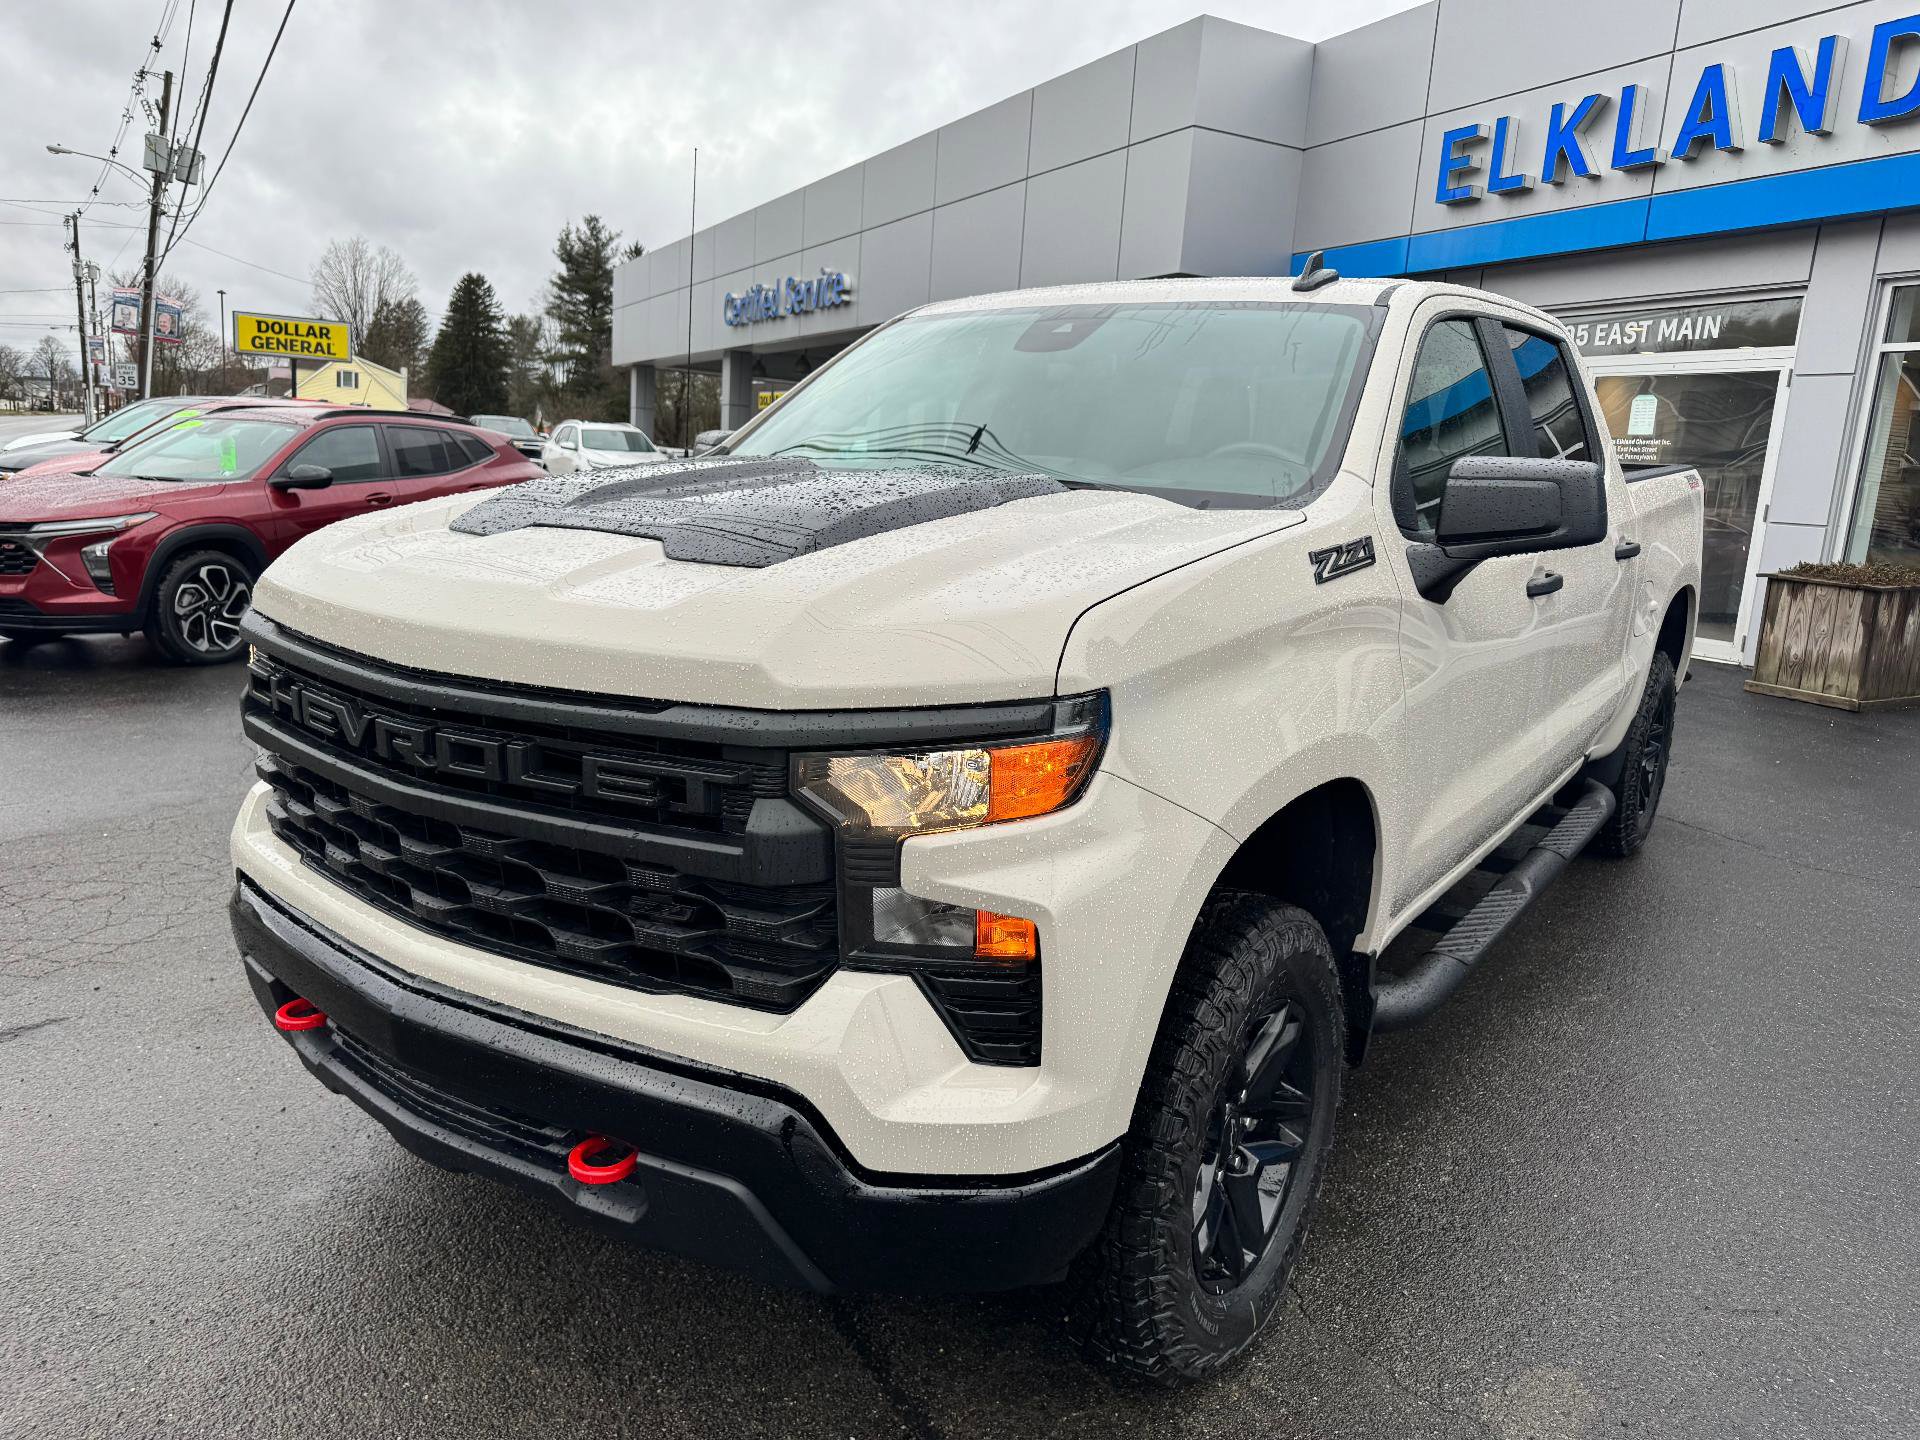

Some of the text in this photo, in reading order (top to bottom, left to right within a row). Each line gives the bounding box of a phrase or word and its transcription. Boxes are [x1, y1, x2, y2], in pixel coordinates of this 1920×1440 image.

[1435, 15, 1920, 204] ELKLAND
[724, 267, 850, 327] Certified Service
[251, 335, 337, 356] GENERAL
[256, 319, 331, 340] DOLLAR
[1594, 320, 1654, 346] EAST
[1657, 315, 1722, 342] MAIN
[118, 375, 136, 386] 35
[1308, 535, 1376, 585] Z71
[247, 661, 751, 816] CHEVROLET
